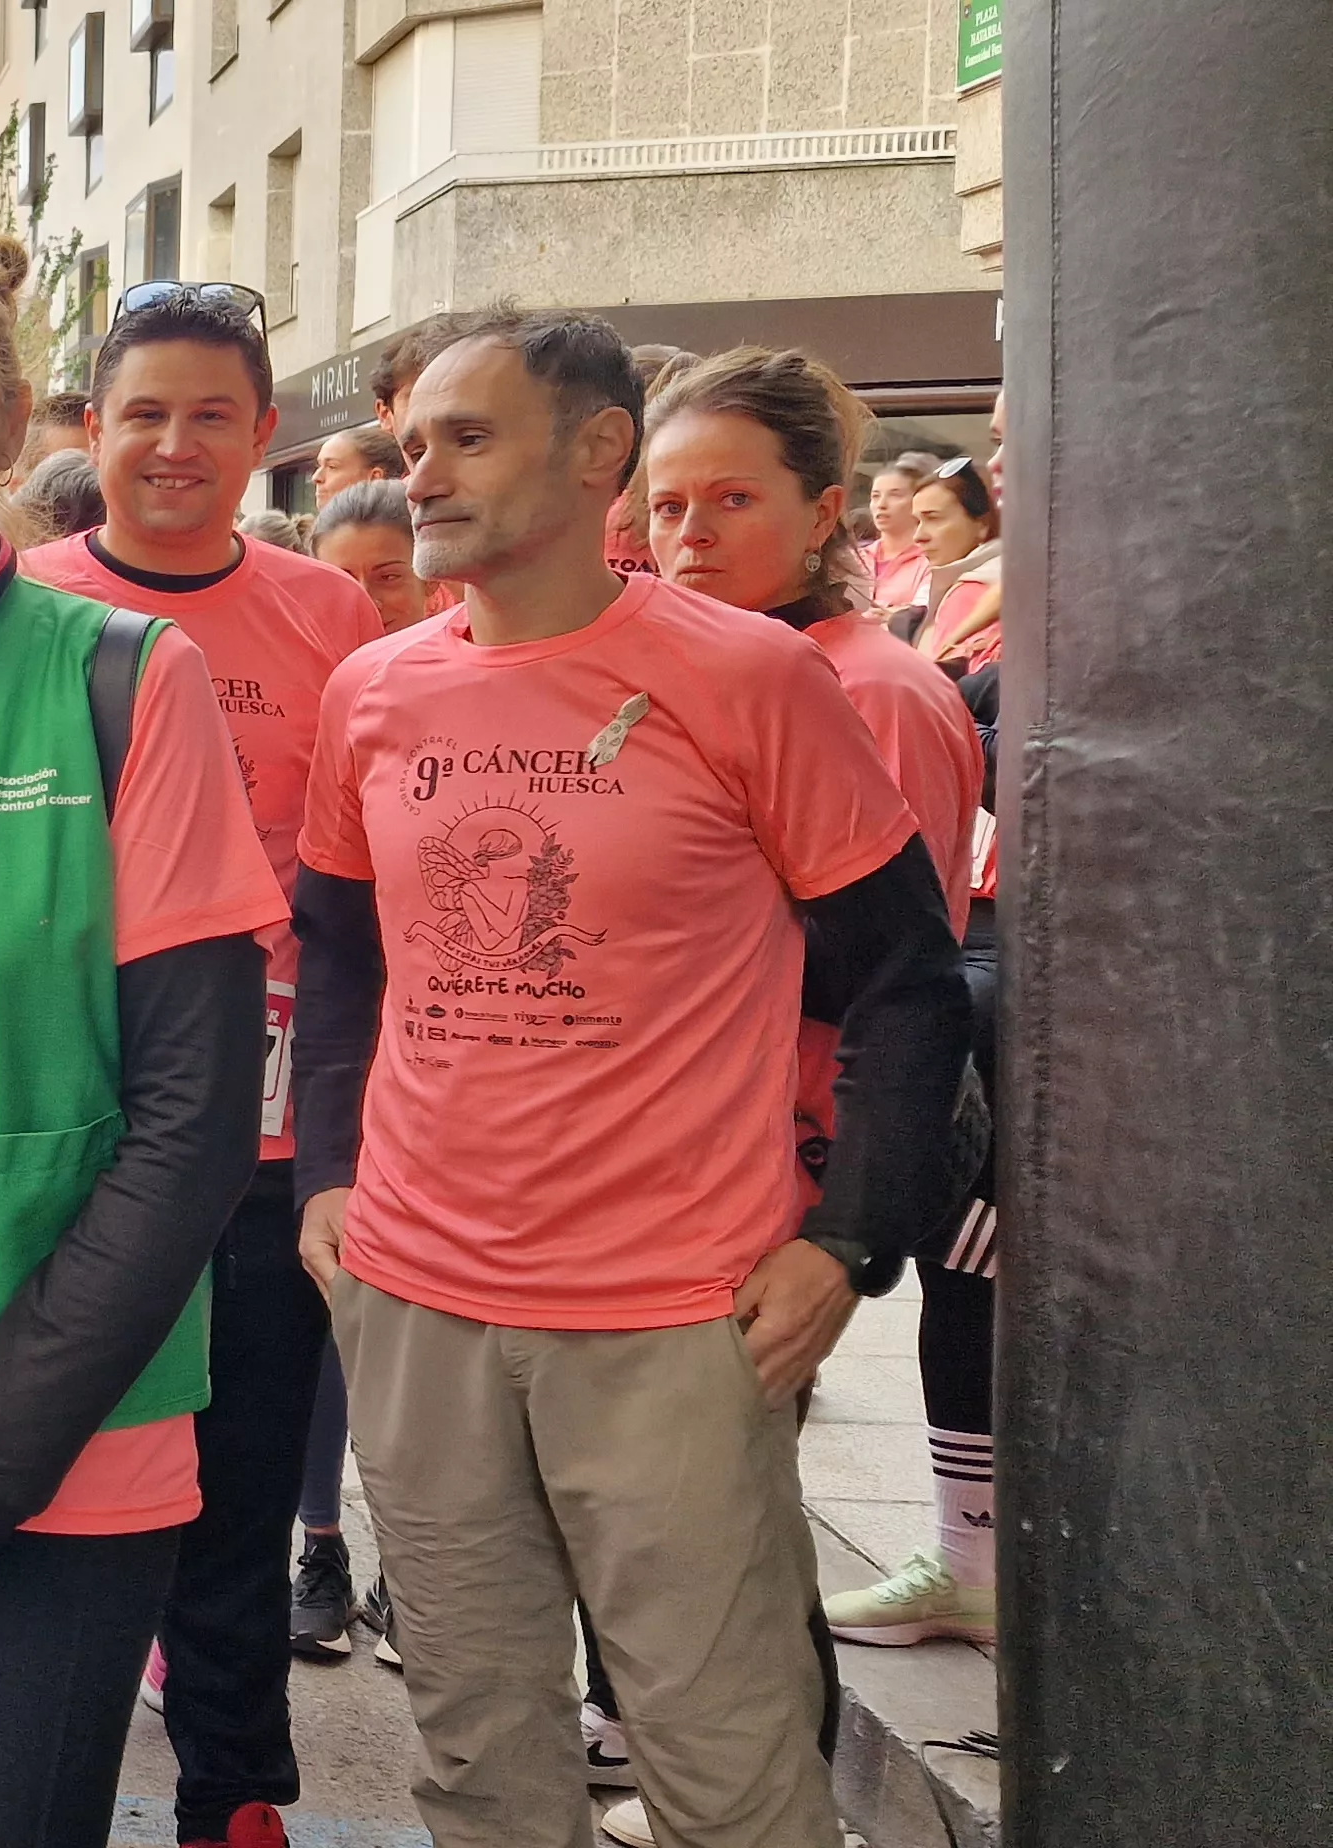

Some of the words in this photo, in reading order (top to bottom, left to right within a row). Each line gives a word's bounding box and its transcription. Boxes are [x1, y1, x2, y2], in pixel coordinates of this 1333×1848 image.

[975, 4, 999, 27] PLAZA
[311, 355, 360, 409] MIRATE
[211, 678, 264, 700] CER
[413, 756, 454, 801] 9ª
[528, 776, 625, 795] HUESCA
[36, 795, 47, 807] el
[50, 794, 93, 805] cáncer
[514, 980, 586, 999] MUCHO
